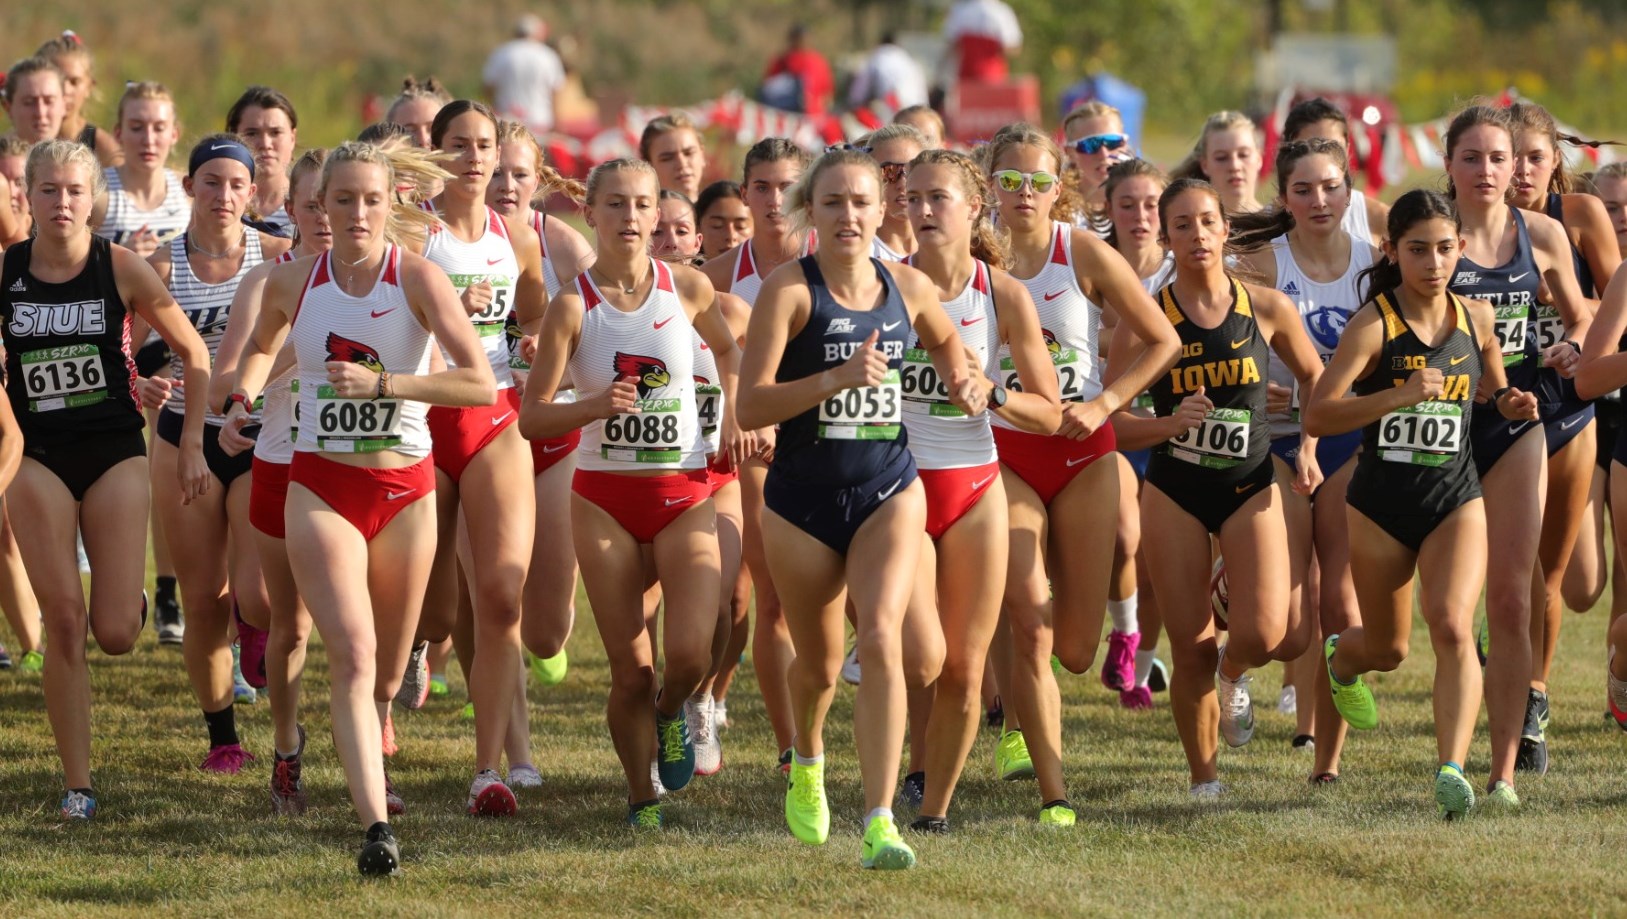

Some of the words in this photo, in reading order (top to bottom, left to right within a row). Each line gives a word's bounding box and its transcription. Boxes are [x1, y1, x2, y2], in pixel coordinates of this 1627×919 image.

[9, 299, 106, 337] SIUE
[824, 340, 904, 362] BUER
[28, 359, 100, 394] 6136
[1170, 356, 1260, 394] IOWA
[320, 402, 396, 432] 6087
[825, 387, 896, 418] 6053
[605, 414, 678, 443] 6088
[1383, 415, 1456, 447] 6102
